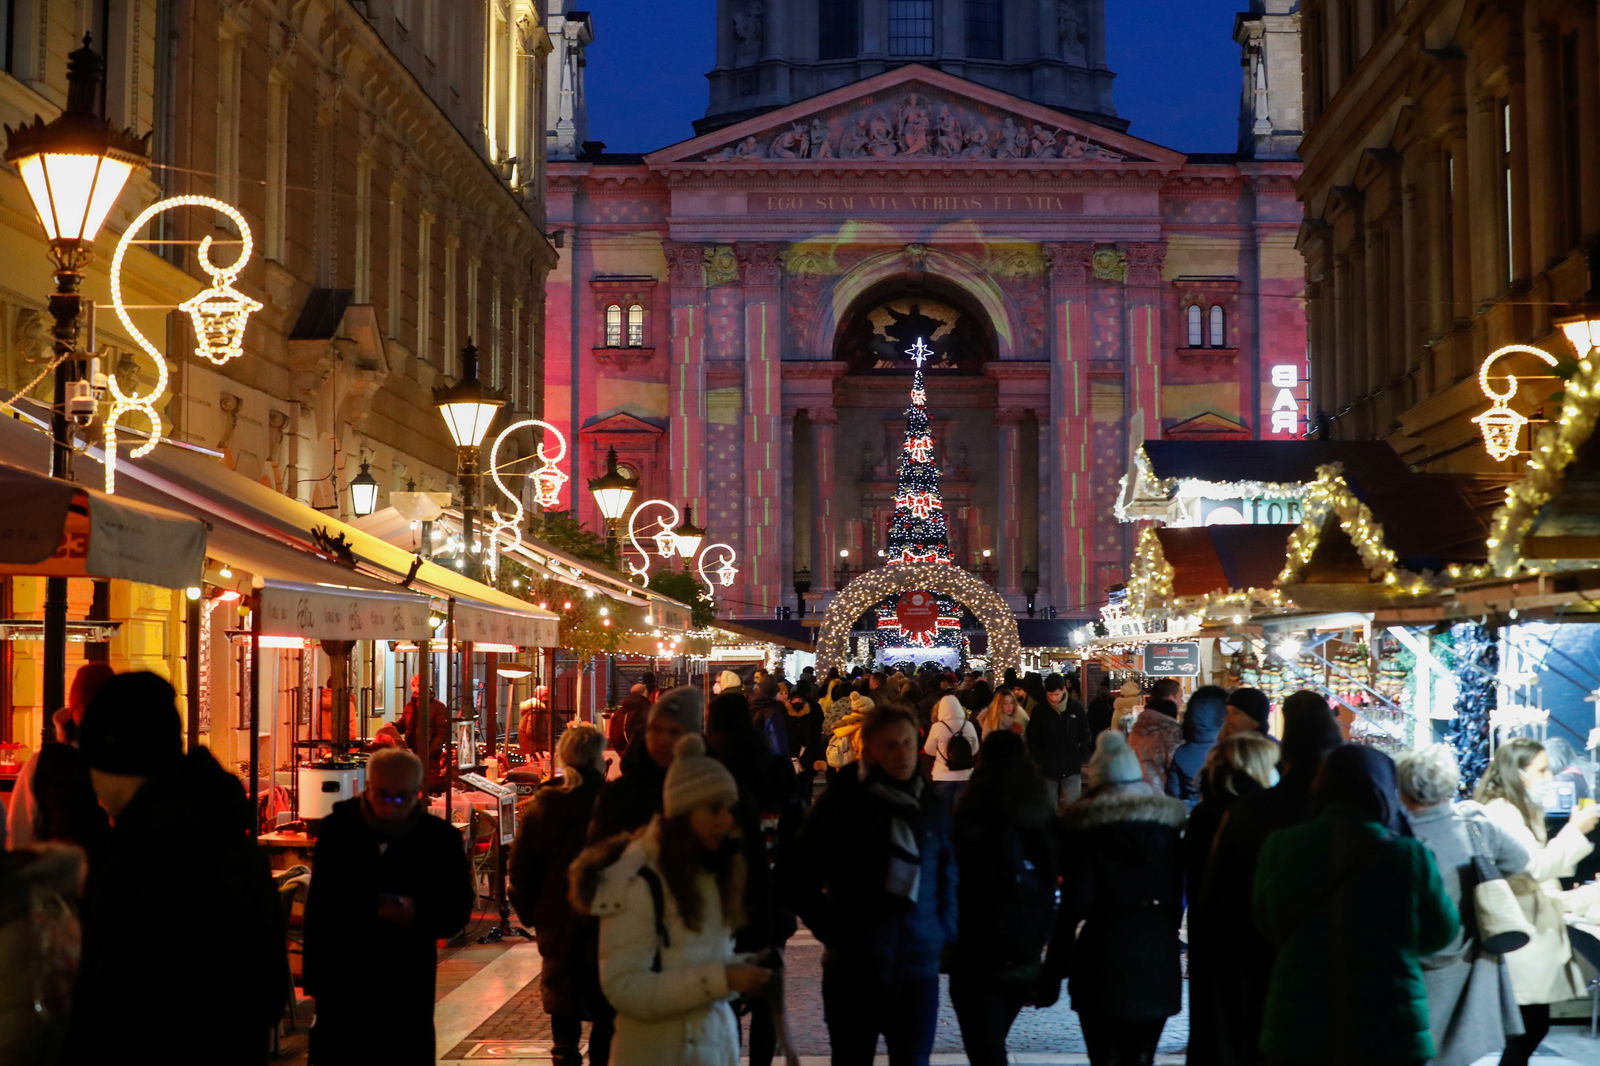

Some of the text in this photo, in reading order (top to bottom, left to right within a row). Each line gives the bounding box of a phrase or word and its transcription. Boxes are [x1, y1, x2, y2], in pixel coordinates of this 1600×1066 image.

[767, 196, 1064, 210] EGO SUM VIA VERITAS ET VITA
